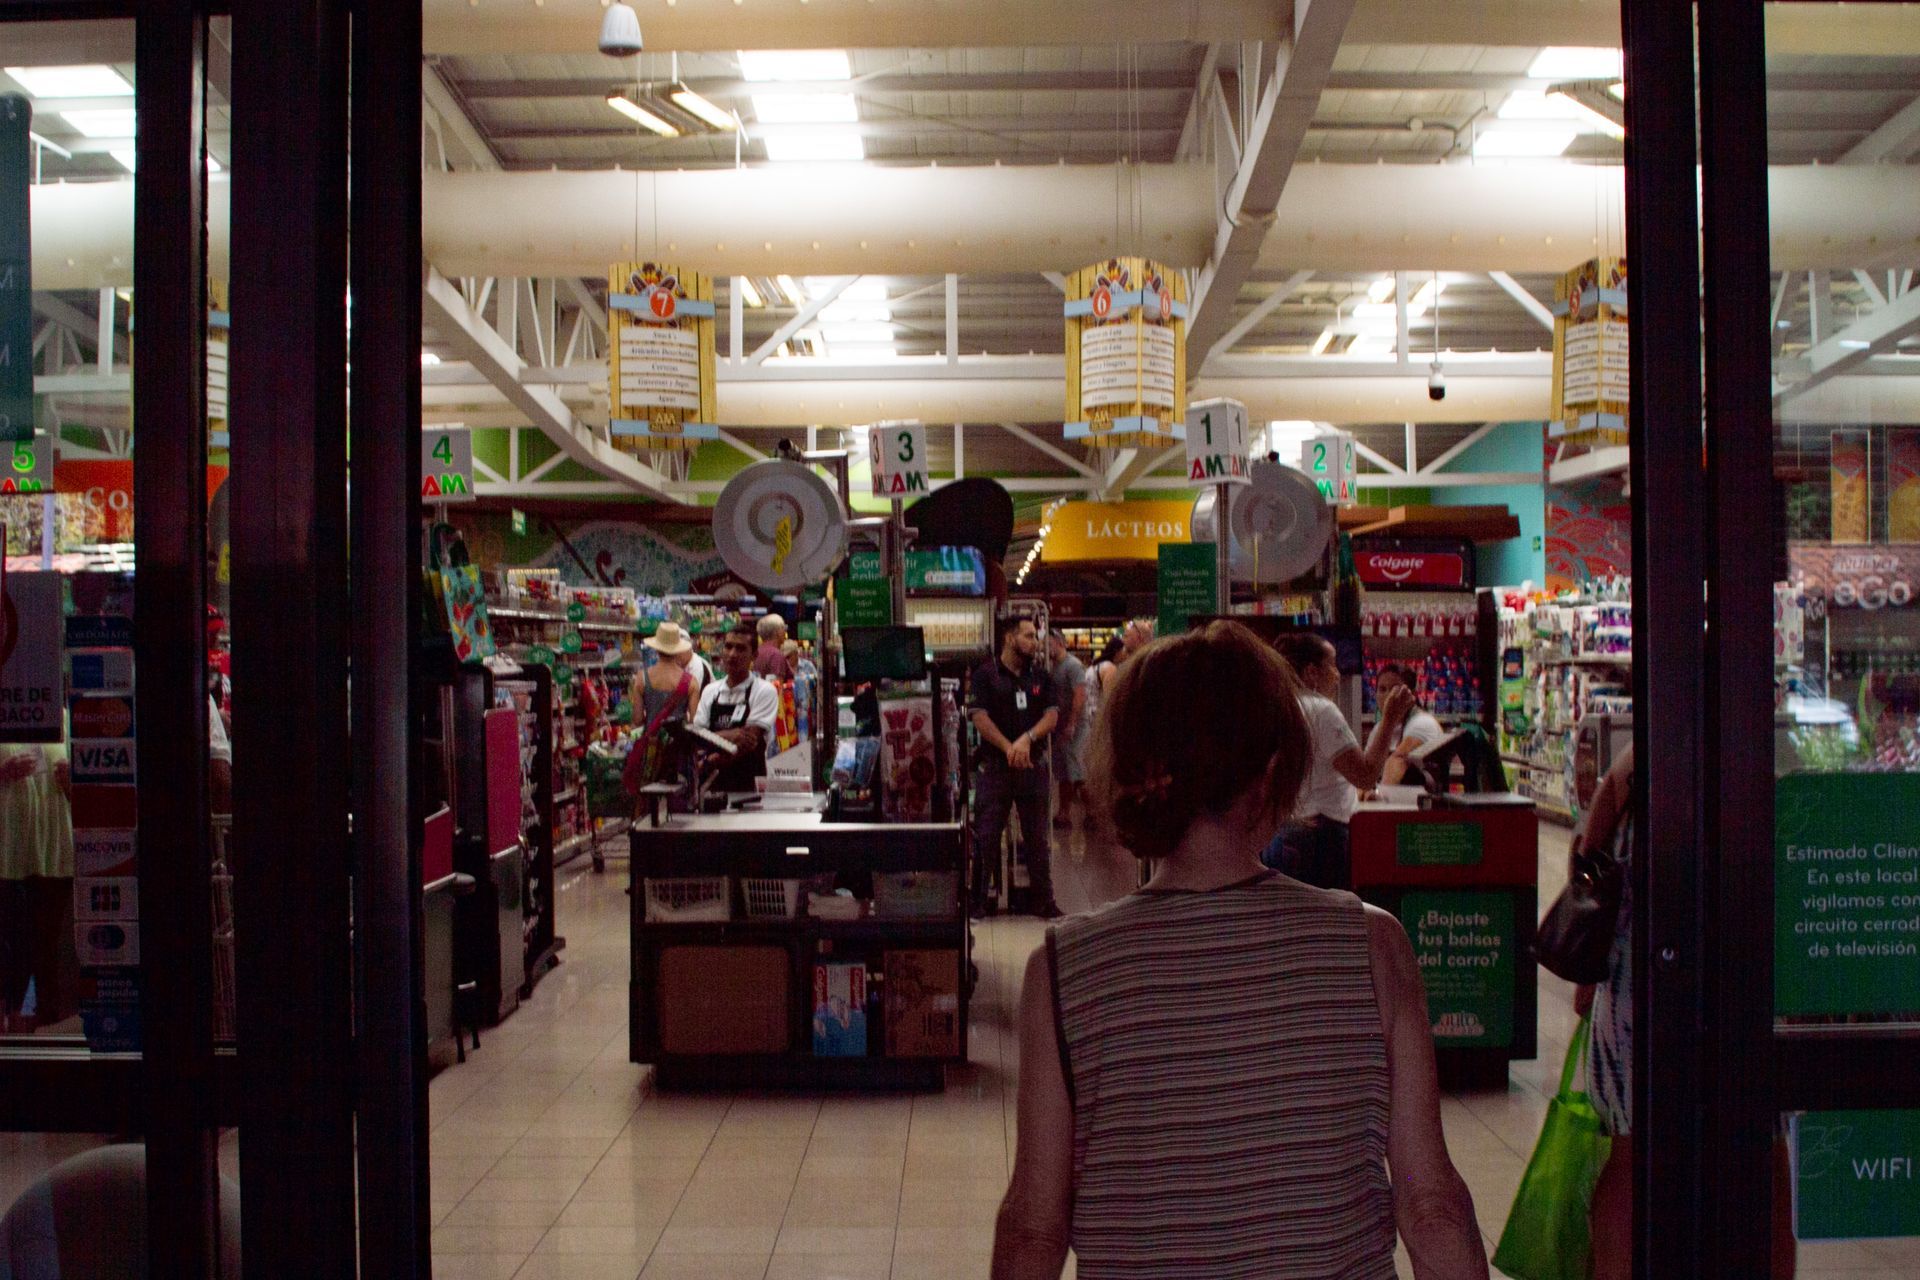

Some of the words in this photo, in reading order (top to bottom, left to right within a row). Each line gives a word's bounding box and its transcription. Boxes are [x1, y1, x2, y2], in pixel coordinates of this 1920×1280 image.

[656, 292, 669, 314] 7
[1097, 296, 1107, 315] 6
[1163, 296, 1170, 315] 6
[1200, 413, 1212, 445] 1
[11, 440, 36, 473] 5
[431, 435, 454, 465] 4
[897, 431, 914, 462] 3
[1345, 442, 1353, 471] 2
[1191, 455, 1225, 480] AM
[1313, 443, 1328, 472] 2
[422, 473, 468, 497] AM
[891, 470, 925, 493] AM
[1369, 554, 1425, 571] Colgate
[29, 688, 51, 702] DE
[77, 748, 130, 768] VISA
[76, 841, 131, 854] DISCOVER
[1786, 843, 1868, 860] Estimado
[1807, 869, 1829, 885] En
[1835, 869, 1870, 885] este
[1876, 868, 1918, 885] local
[1802, 892, 1885, 912] vigilamos
[1794, 916, 1858, 933] circuito
[1418, 931, 1443, 946] tus
[1448, 931, 1501, 946] bolsas
[1808, 941, 1829, 957] de
[1835, 940, 1917, 957] televisión
[1417, 951, 1442, 967] del
[1447, 951, 1500, 967] carro?
[1852, 1157, 1912, 1180] WIFI
